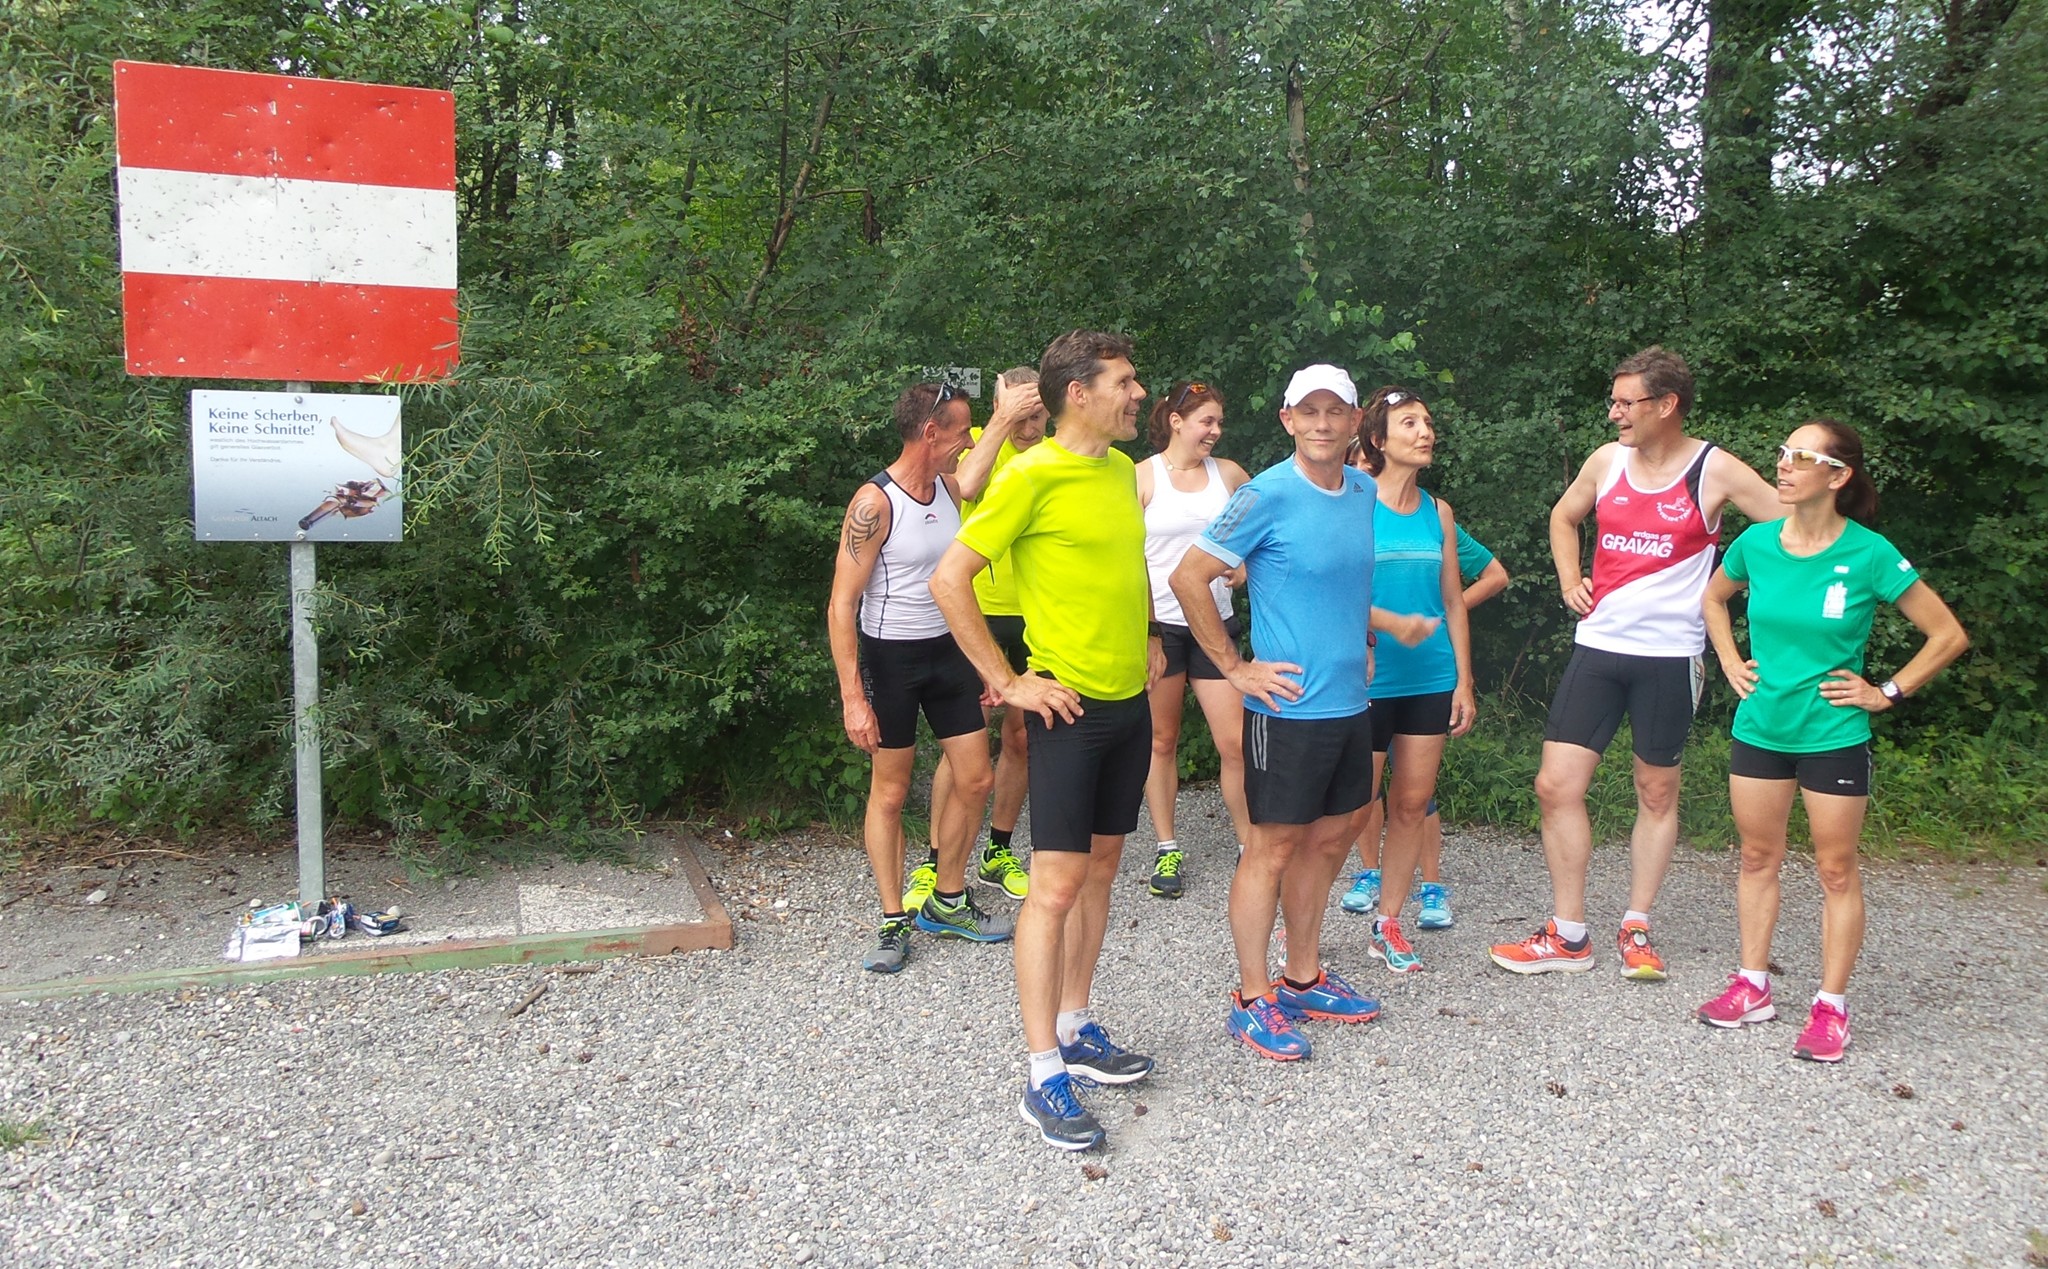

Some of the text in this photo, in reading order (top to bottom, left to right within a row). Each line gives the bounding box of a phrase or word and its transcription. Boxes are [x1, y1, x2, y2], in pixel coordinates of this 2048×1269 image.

[208, 408, 323, 424] Keine Scherben,
[208, 422, 315, 436] Keine Schnitte!
[1632, 530, 1660, 540] erdgas
[1601, 533, 1674, 558] GRAVAG
